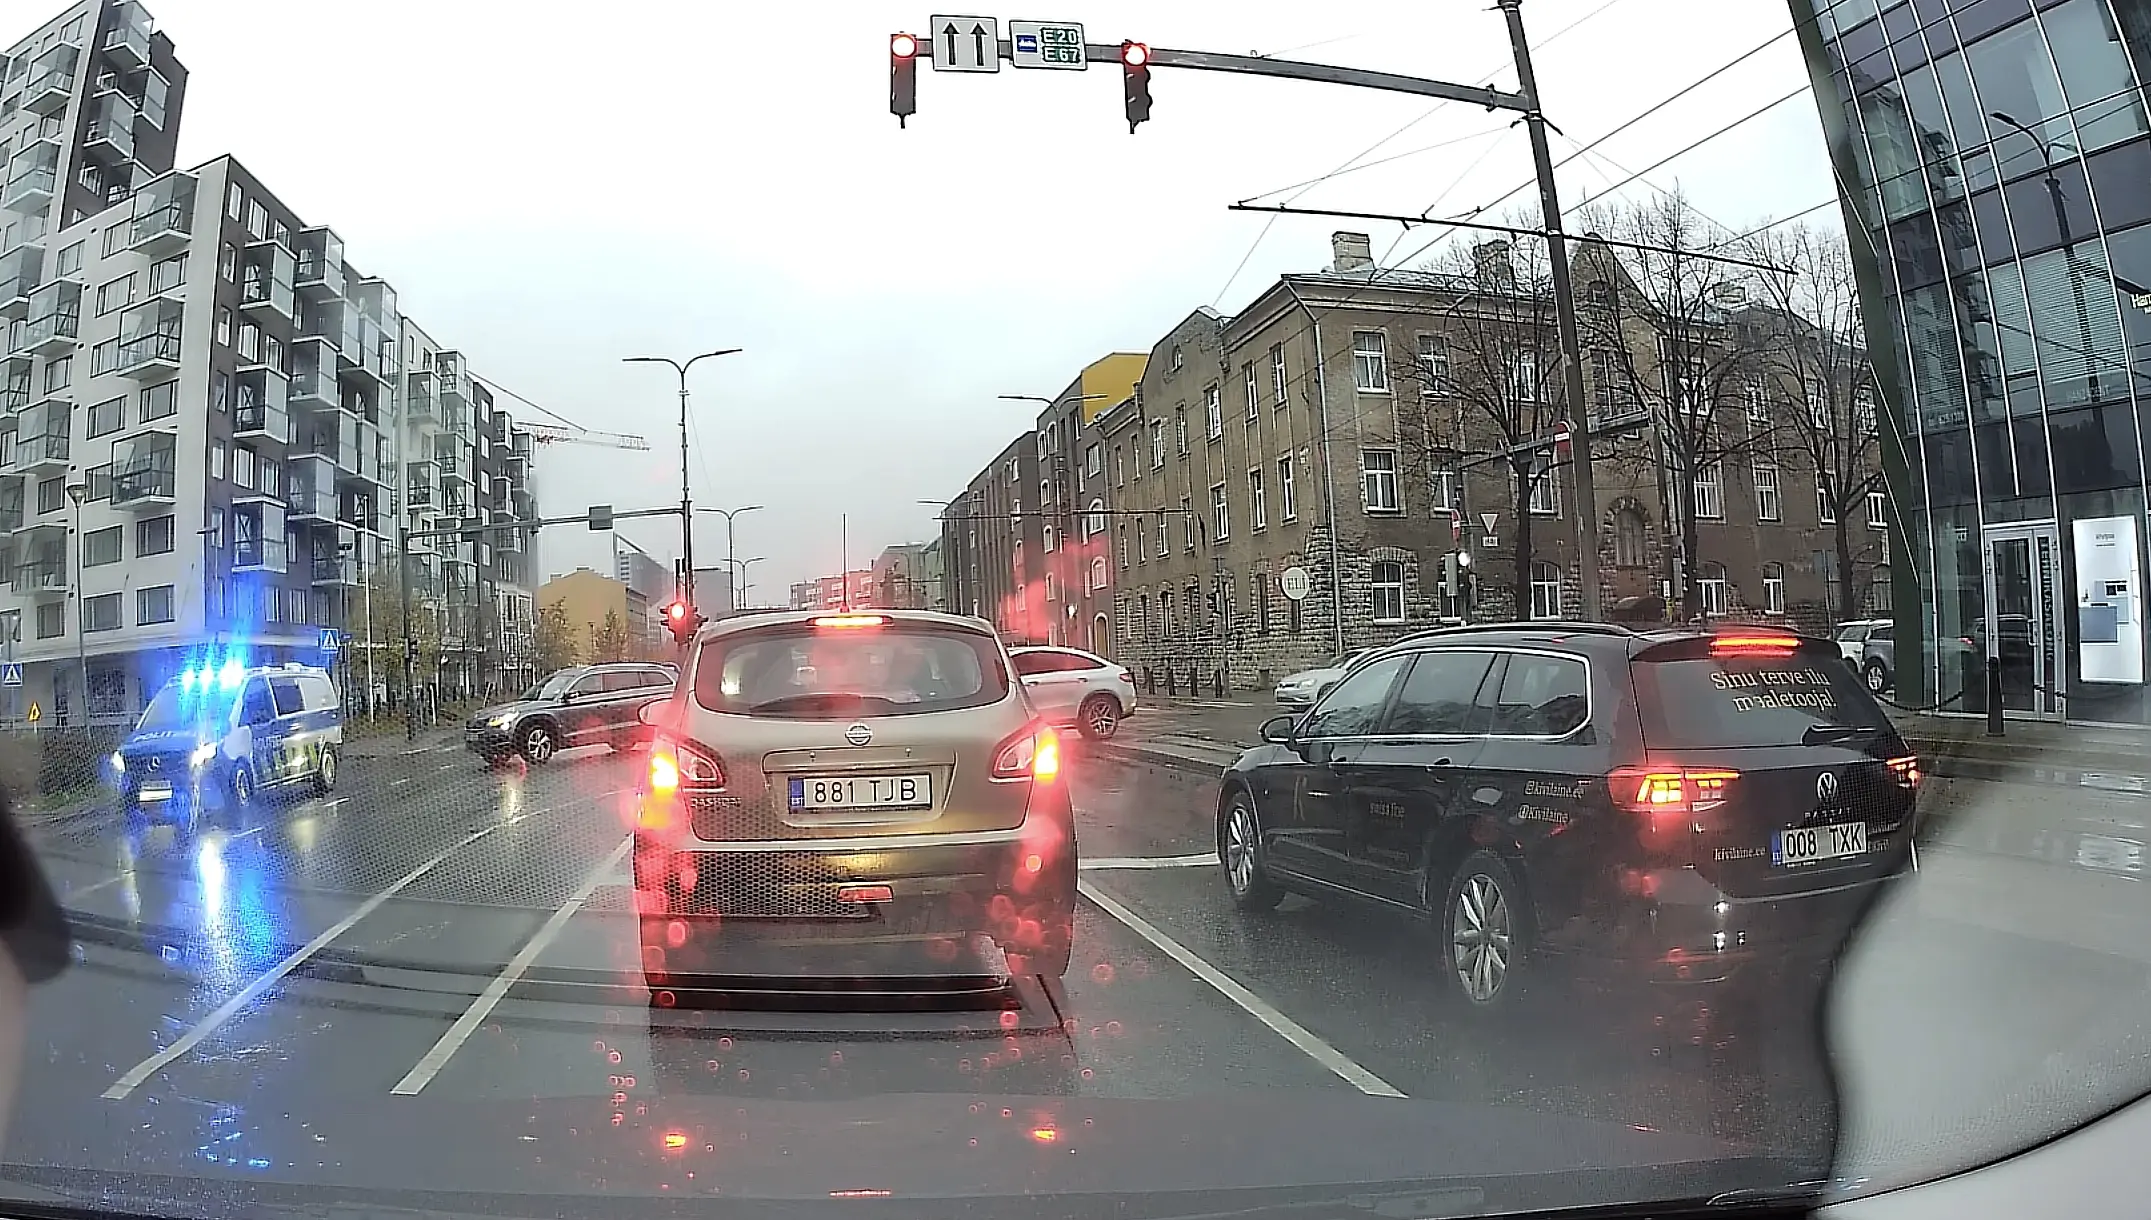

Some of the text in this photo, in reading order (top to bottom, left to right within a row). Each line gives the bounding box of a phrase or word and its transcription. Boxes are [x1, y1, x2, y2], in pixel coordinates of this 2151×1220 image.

[1710, 667, 1831, 690] Sinu terve ilu
[1733, 688, 1837, 712] maaletooja!
[815, 779, 916, 803] 881 TJB
[1786, 830, 1817, 858] 008
[1829, 825, 1862, 854] TXK
